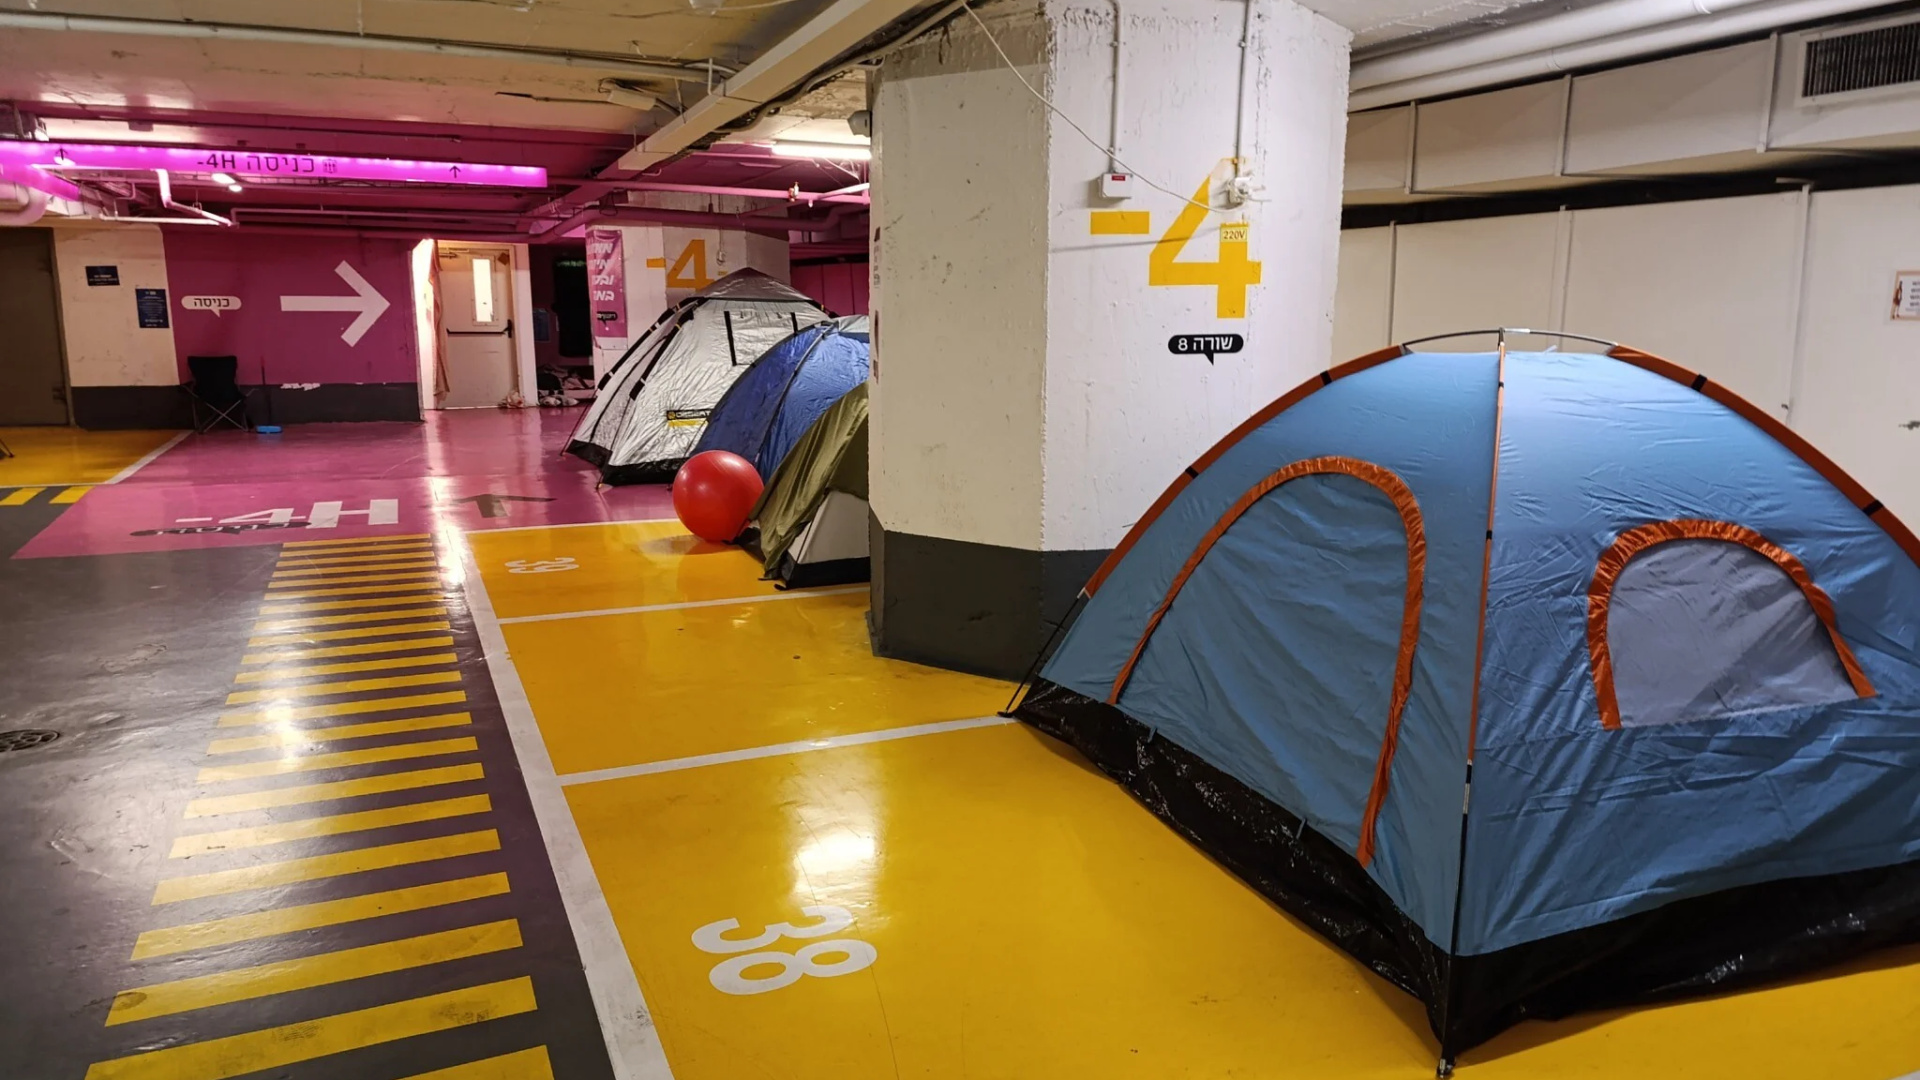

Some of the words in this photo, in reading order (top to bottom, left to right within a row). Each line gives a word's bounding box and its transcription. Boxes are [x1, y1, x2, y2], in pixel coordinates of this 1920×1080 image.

[197, 153, 236, 170] -4H
[246, 155, 315, 173] כניסה
[1222, 230, 1246, 240] 220V
[193, 297, 230, 308] כניסה
[1177, 337, 1189, 351] 8
[1192, 334, 1234, 351] שורה
[175, 499, 399, 529] -4H
[504, 557, 580, 574] 39
[691, 905, 878, 995] 38
